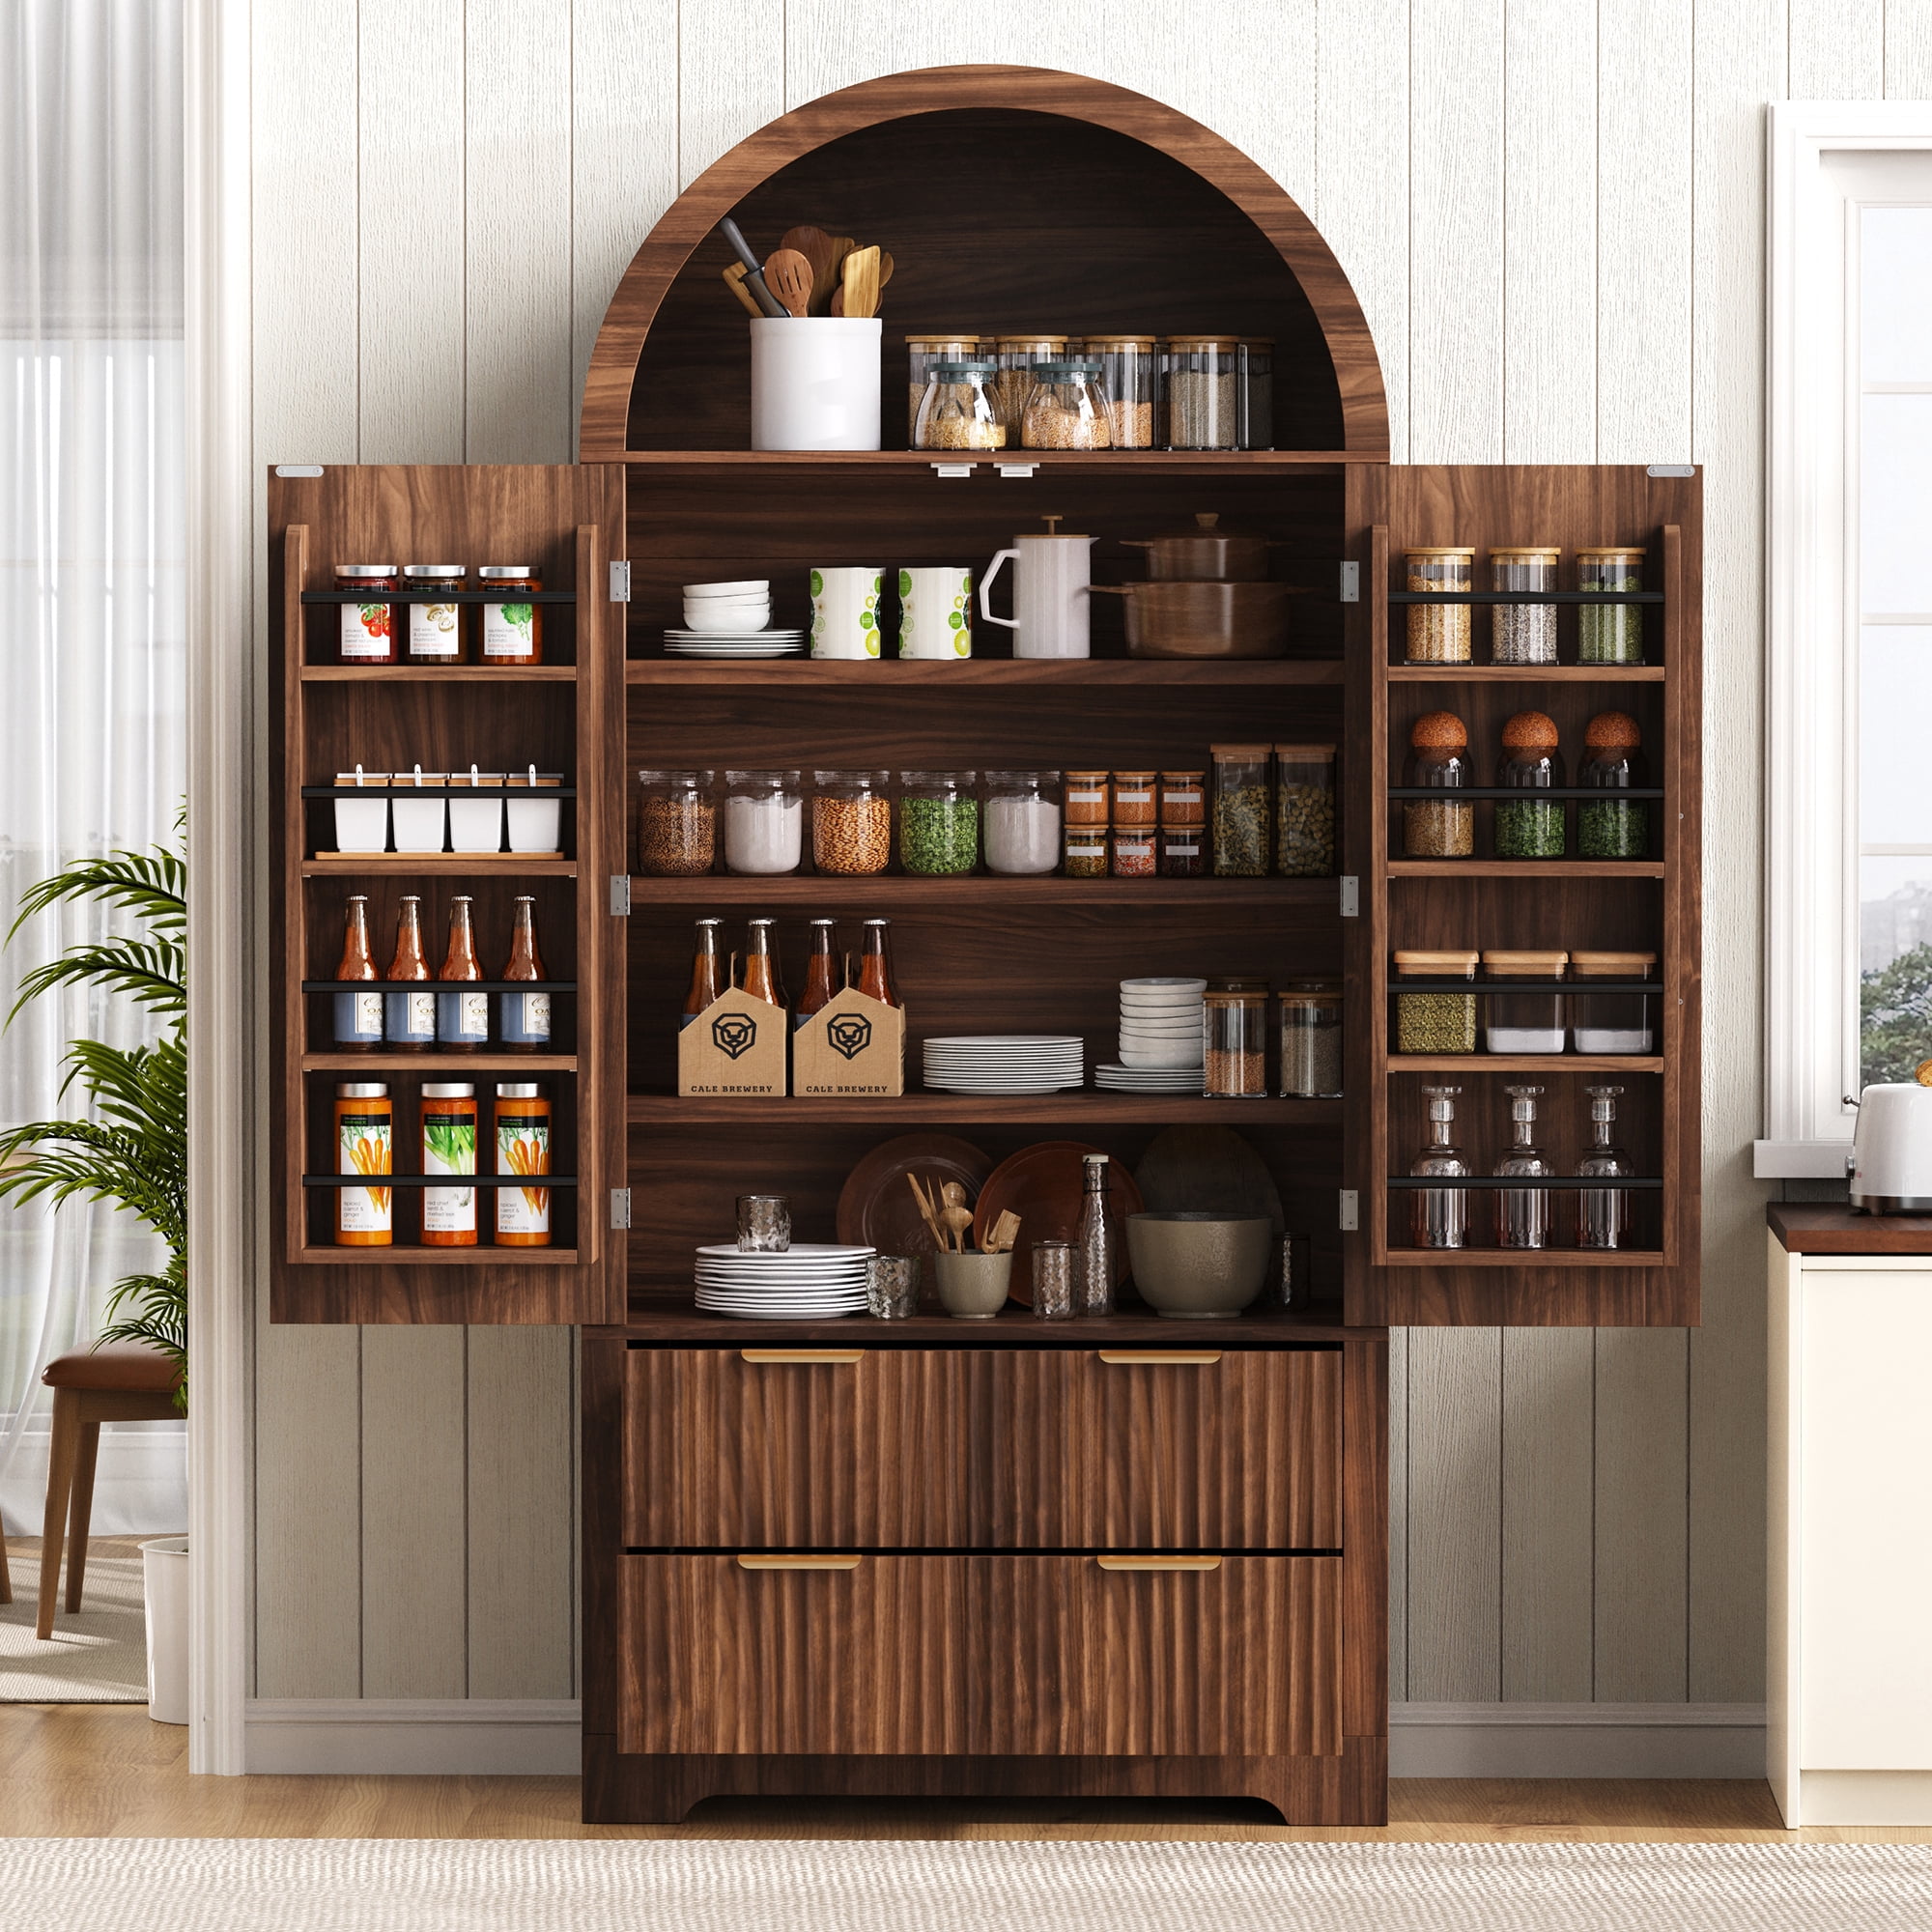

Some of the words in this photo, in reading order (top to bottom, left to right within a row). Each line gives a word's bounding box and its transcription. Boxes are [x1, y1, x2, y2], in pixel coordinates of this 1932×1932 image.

[691, 1085, 718, 1094] CALE
[723, 1085, 773, 1094] BREWERY
[806, 1085, 834, 1094] CALE
[838, 1085, 888, 1094] BREWERY
